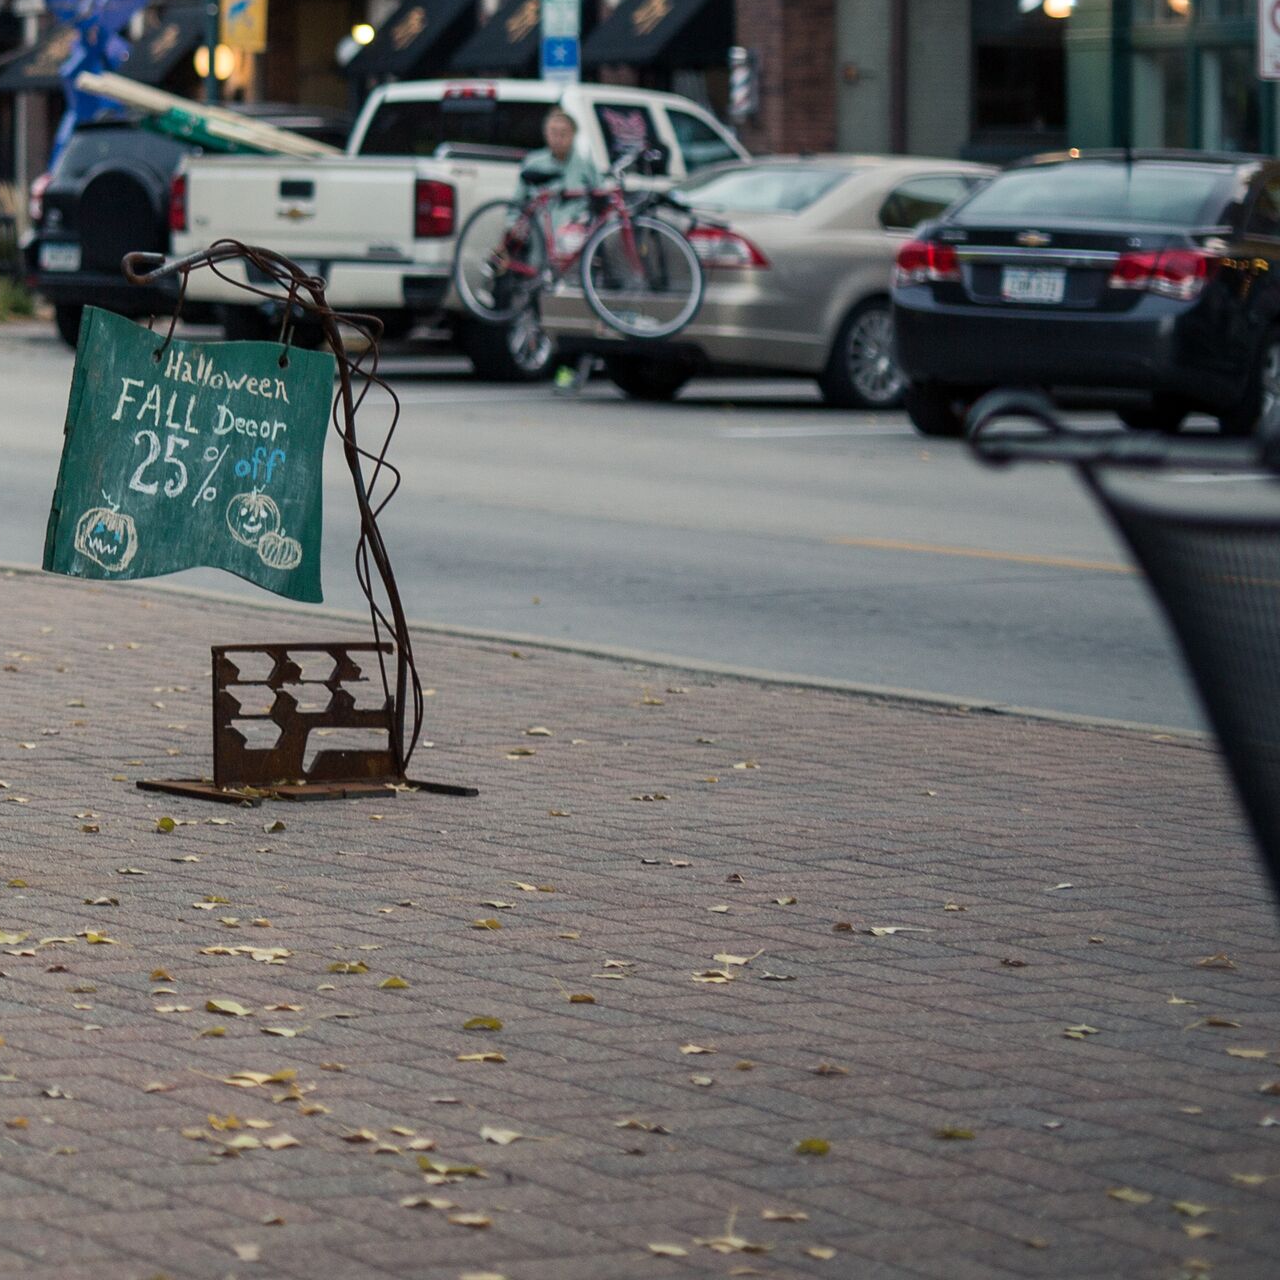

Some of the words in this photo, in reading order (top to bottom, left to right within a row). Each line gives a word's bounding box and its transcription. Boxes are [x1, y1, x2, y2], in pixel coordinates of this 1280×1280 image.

[111, 376, 199, 435] FALL
[212, 404, 287, 442] Decor
[164, 349, 290, 405] Halloween
[128, 429, 230, 508] 25%
[234, 446, 286, 483] off
